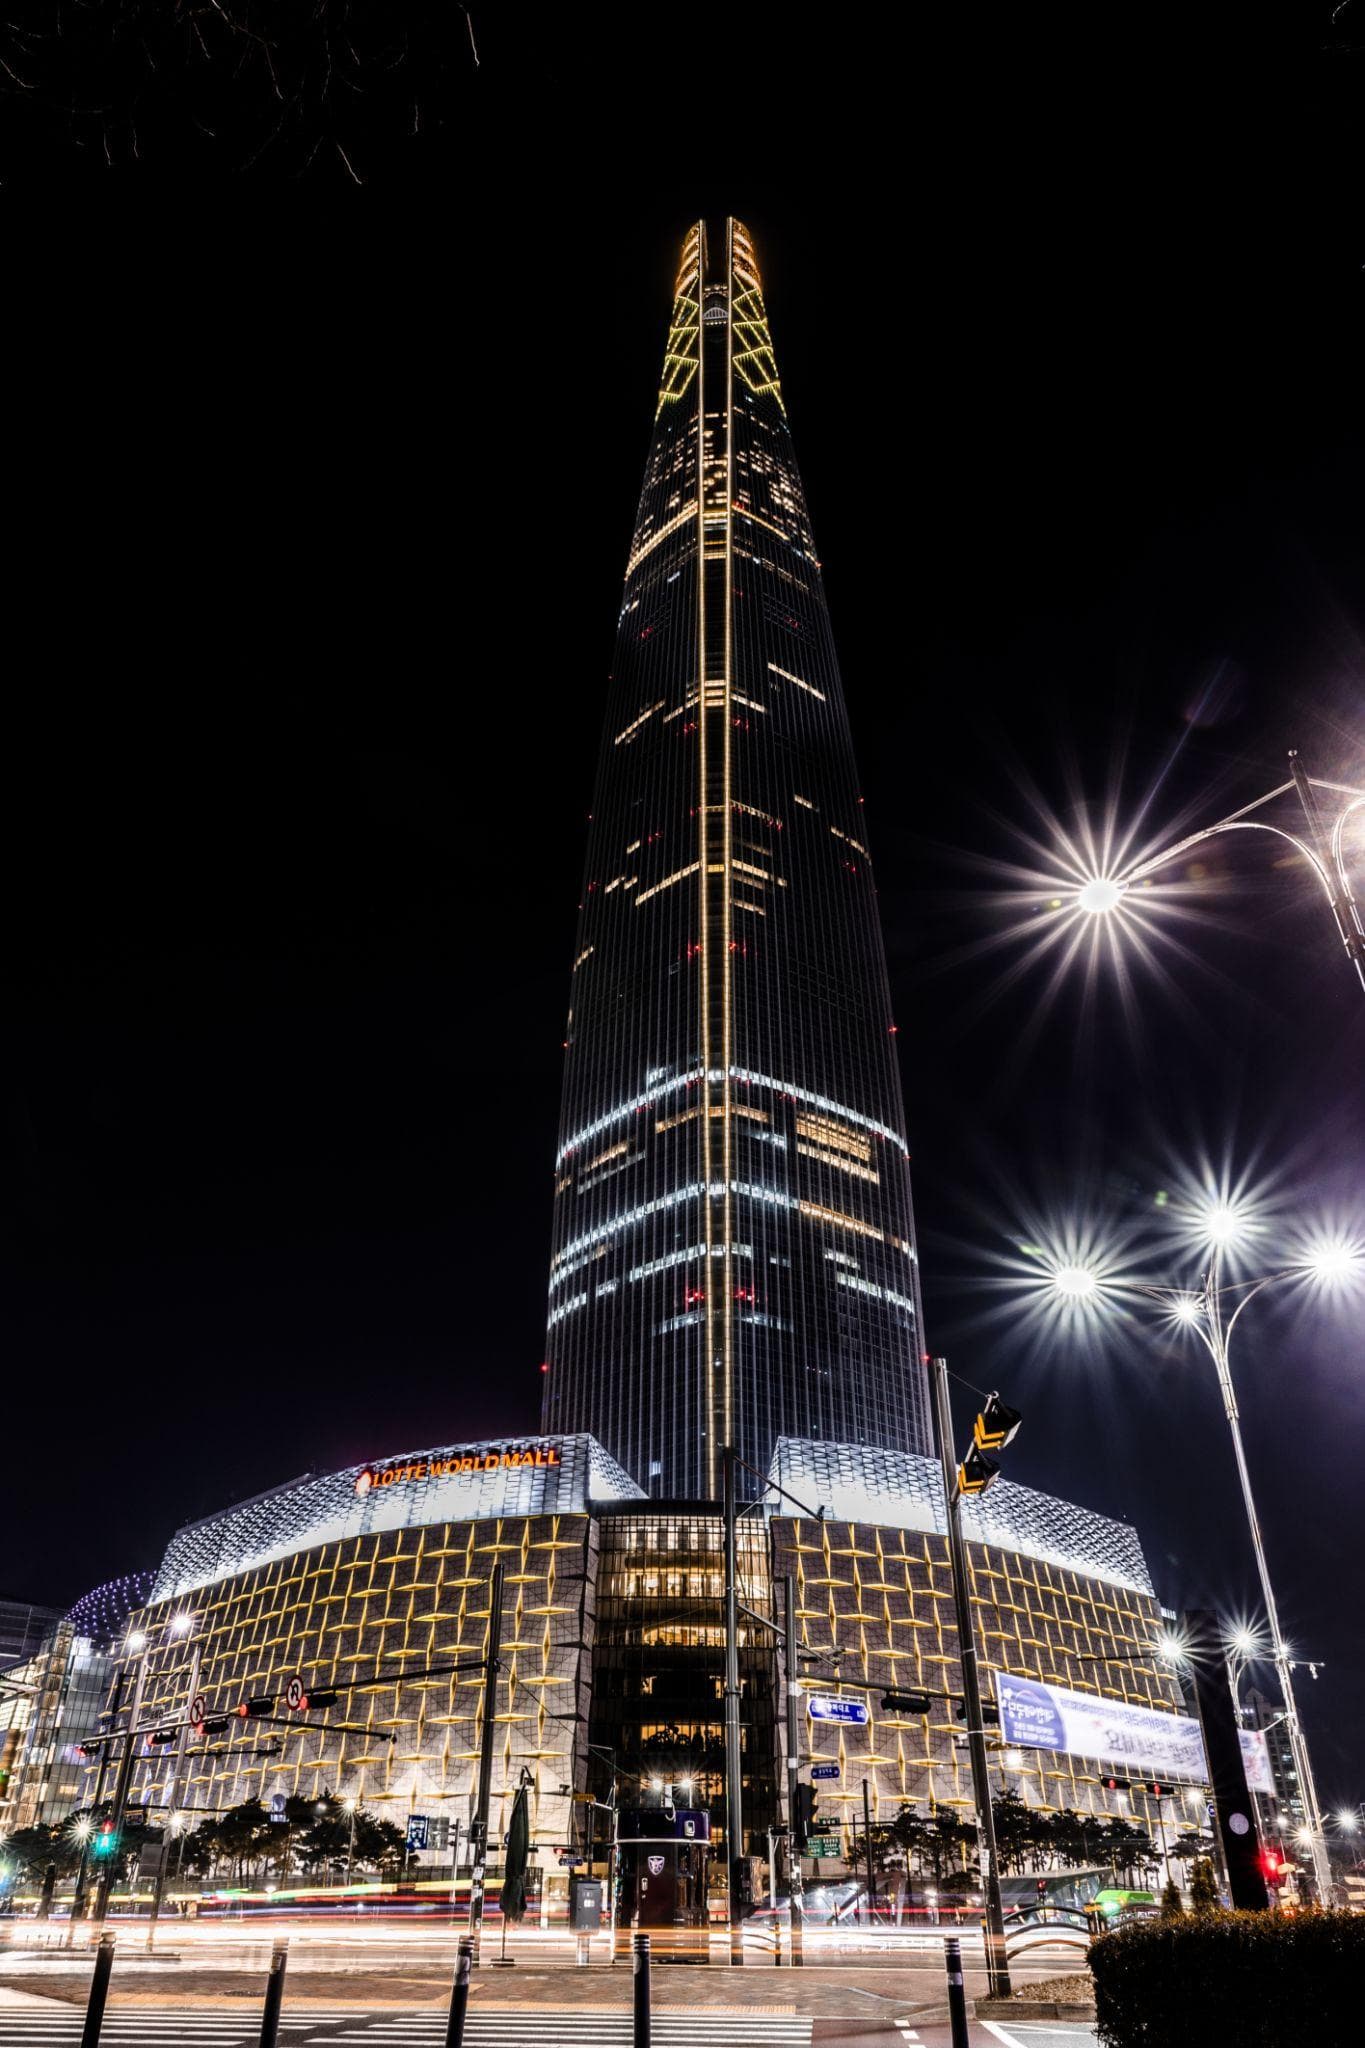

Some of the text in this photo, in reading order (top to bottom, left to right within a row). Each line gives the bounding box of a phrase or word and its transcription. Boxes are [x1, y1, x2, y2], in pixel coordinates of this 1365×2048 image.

[373, 1449, 560, 1488] LOTTE WORLD MALL
